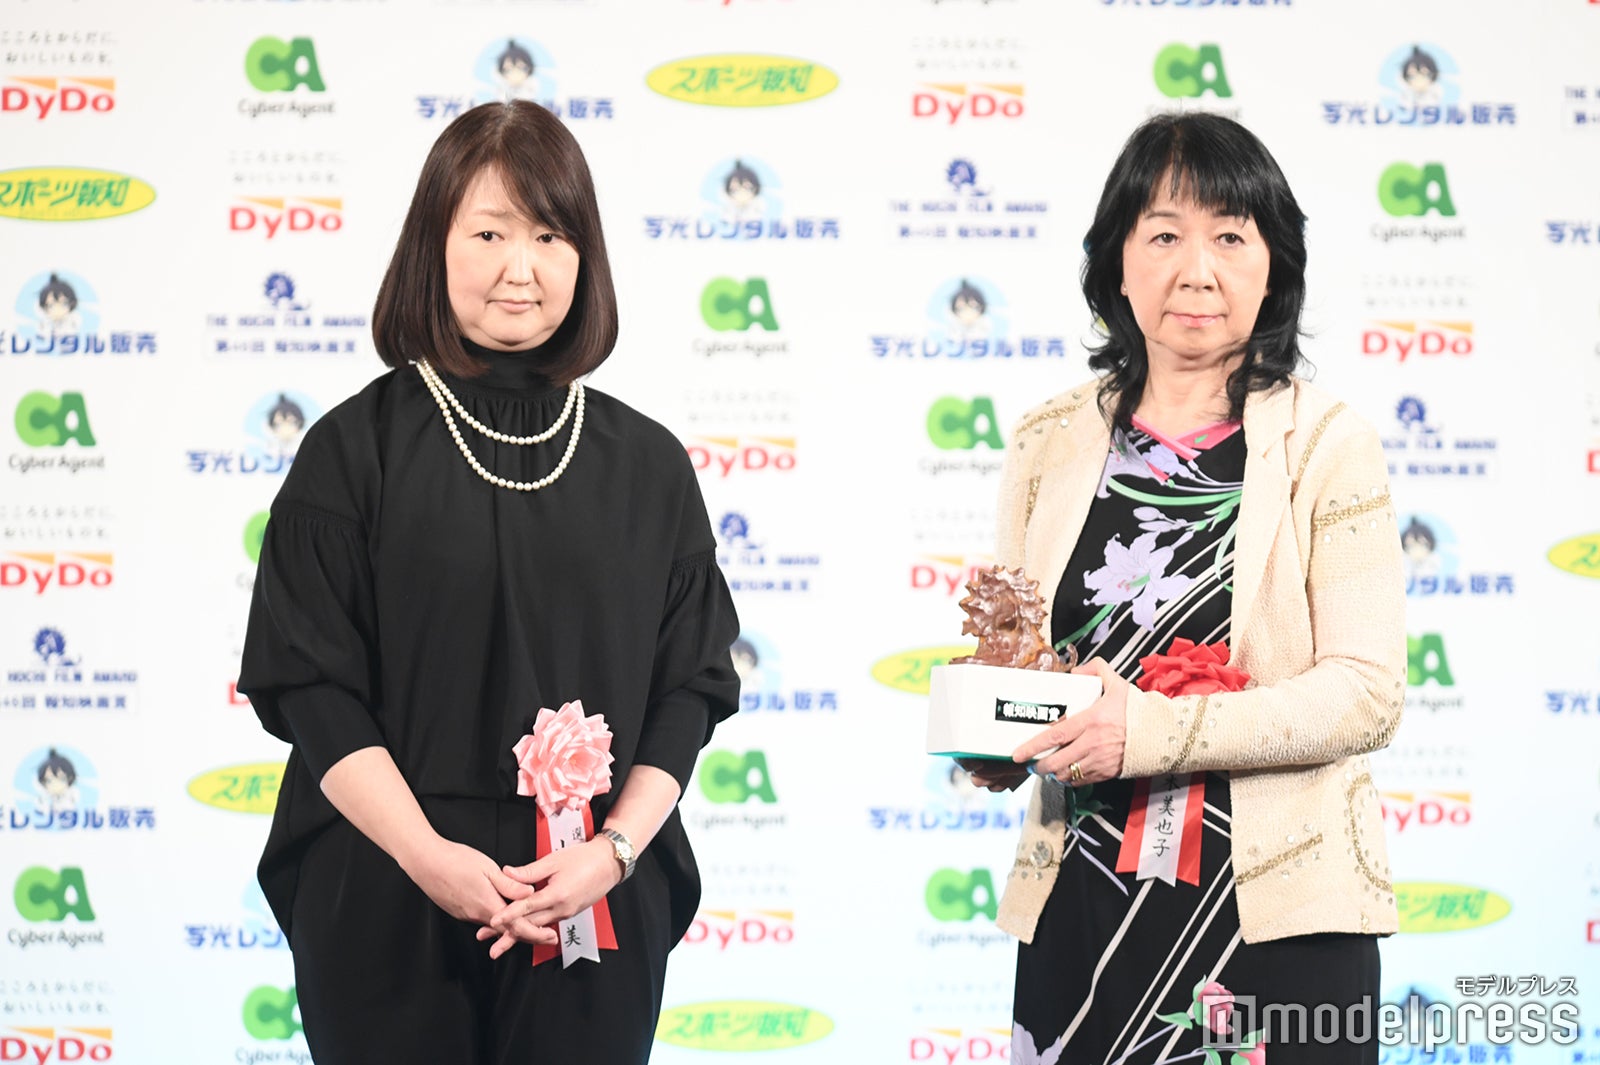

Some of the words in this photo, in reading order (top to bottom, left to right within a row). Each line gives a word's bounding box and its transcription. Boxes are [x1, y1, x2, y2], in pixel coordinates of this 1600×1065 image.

[1, 86, 115, 120] DyDo
[912, 94, 1025, 125] DyDo
[229, 207, 343, 240] DyDo
[1362, 331, 1474, 363] DyDo
[686, 447, 796, 478] DyDo
[0, 562, 113, 595] DyDo
[0, 805, 155, 830] レンタル販売
[683, 919, 794, 950] DyDo
[0, 1036, 112, 1065] DyDo
